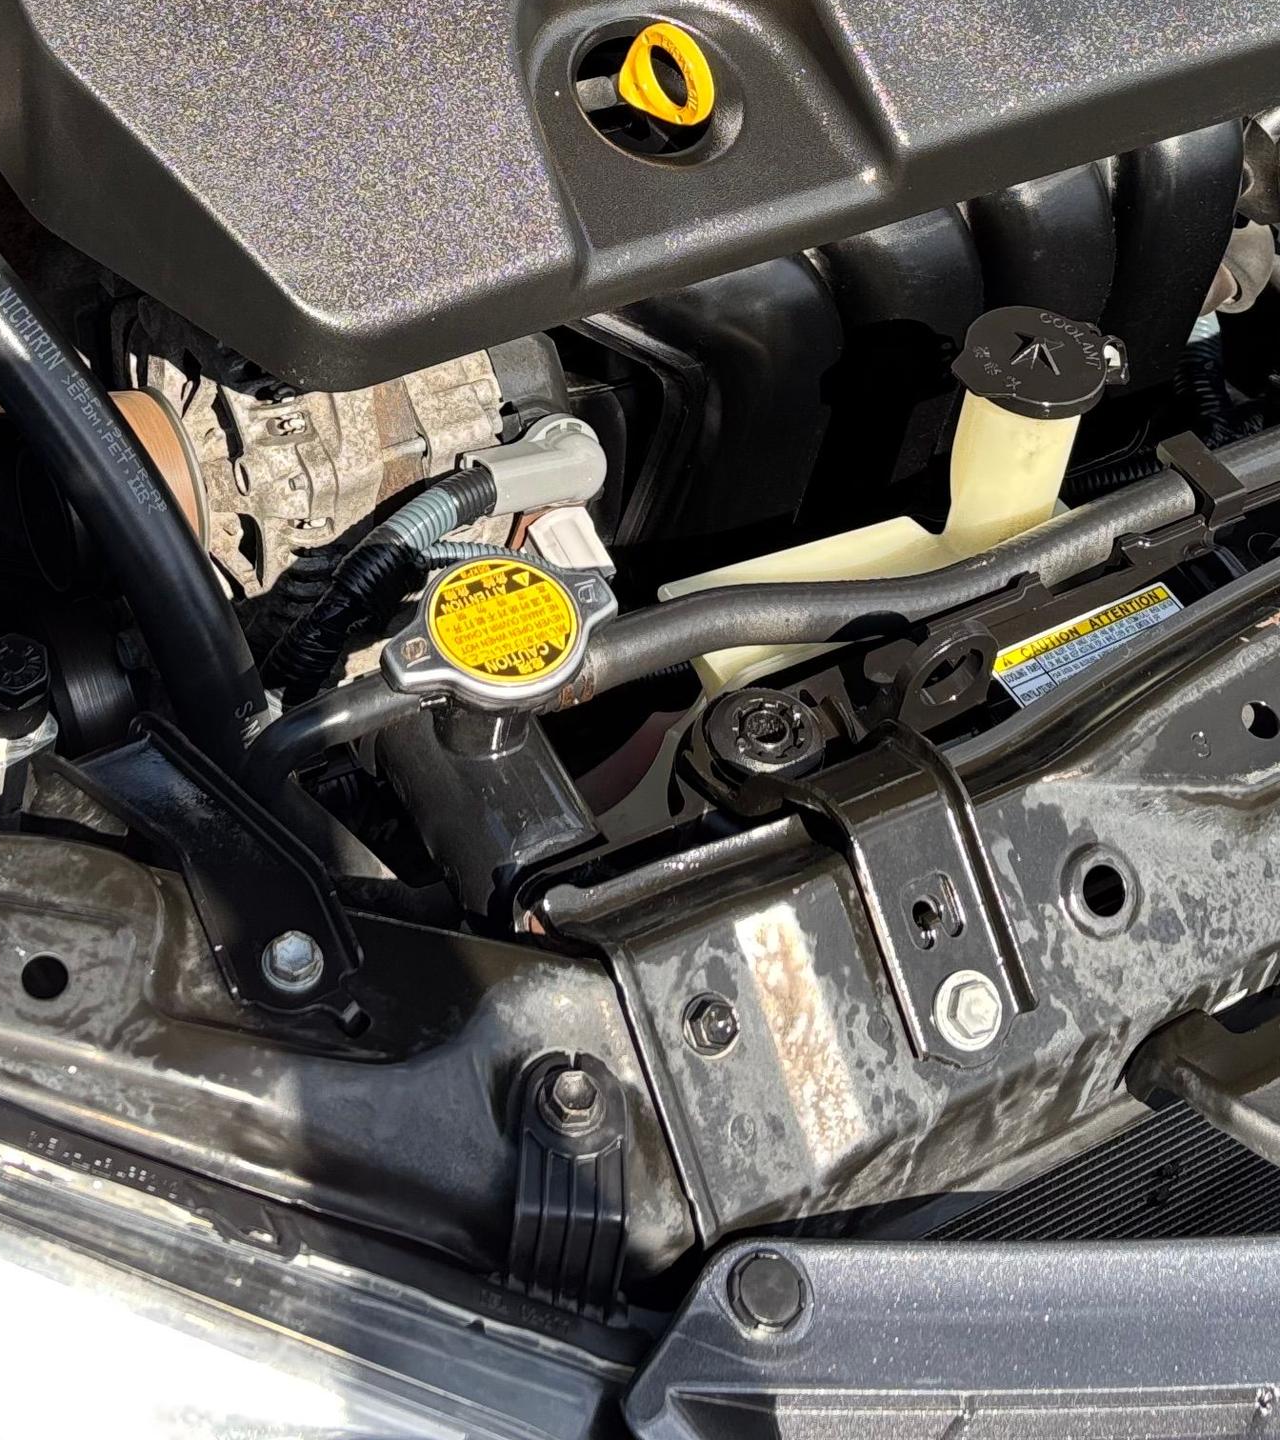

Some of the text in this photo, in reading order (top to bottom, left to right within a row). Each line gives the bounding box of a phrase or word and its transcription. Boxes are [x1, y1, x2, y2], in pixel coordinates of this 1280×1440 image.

[1040, 312, 1102, 370] COOLANT
[440, 584, 507, 615] ATTENTION
[508, 623, 535, 638] OPEN
[1020, 626, 1080, 658] CAUTION
[1088, 591, 1160, 629] ATTENTION
[460, 642, 480, 655] HOT
[484, 642, 550, 674] CAUTION
